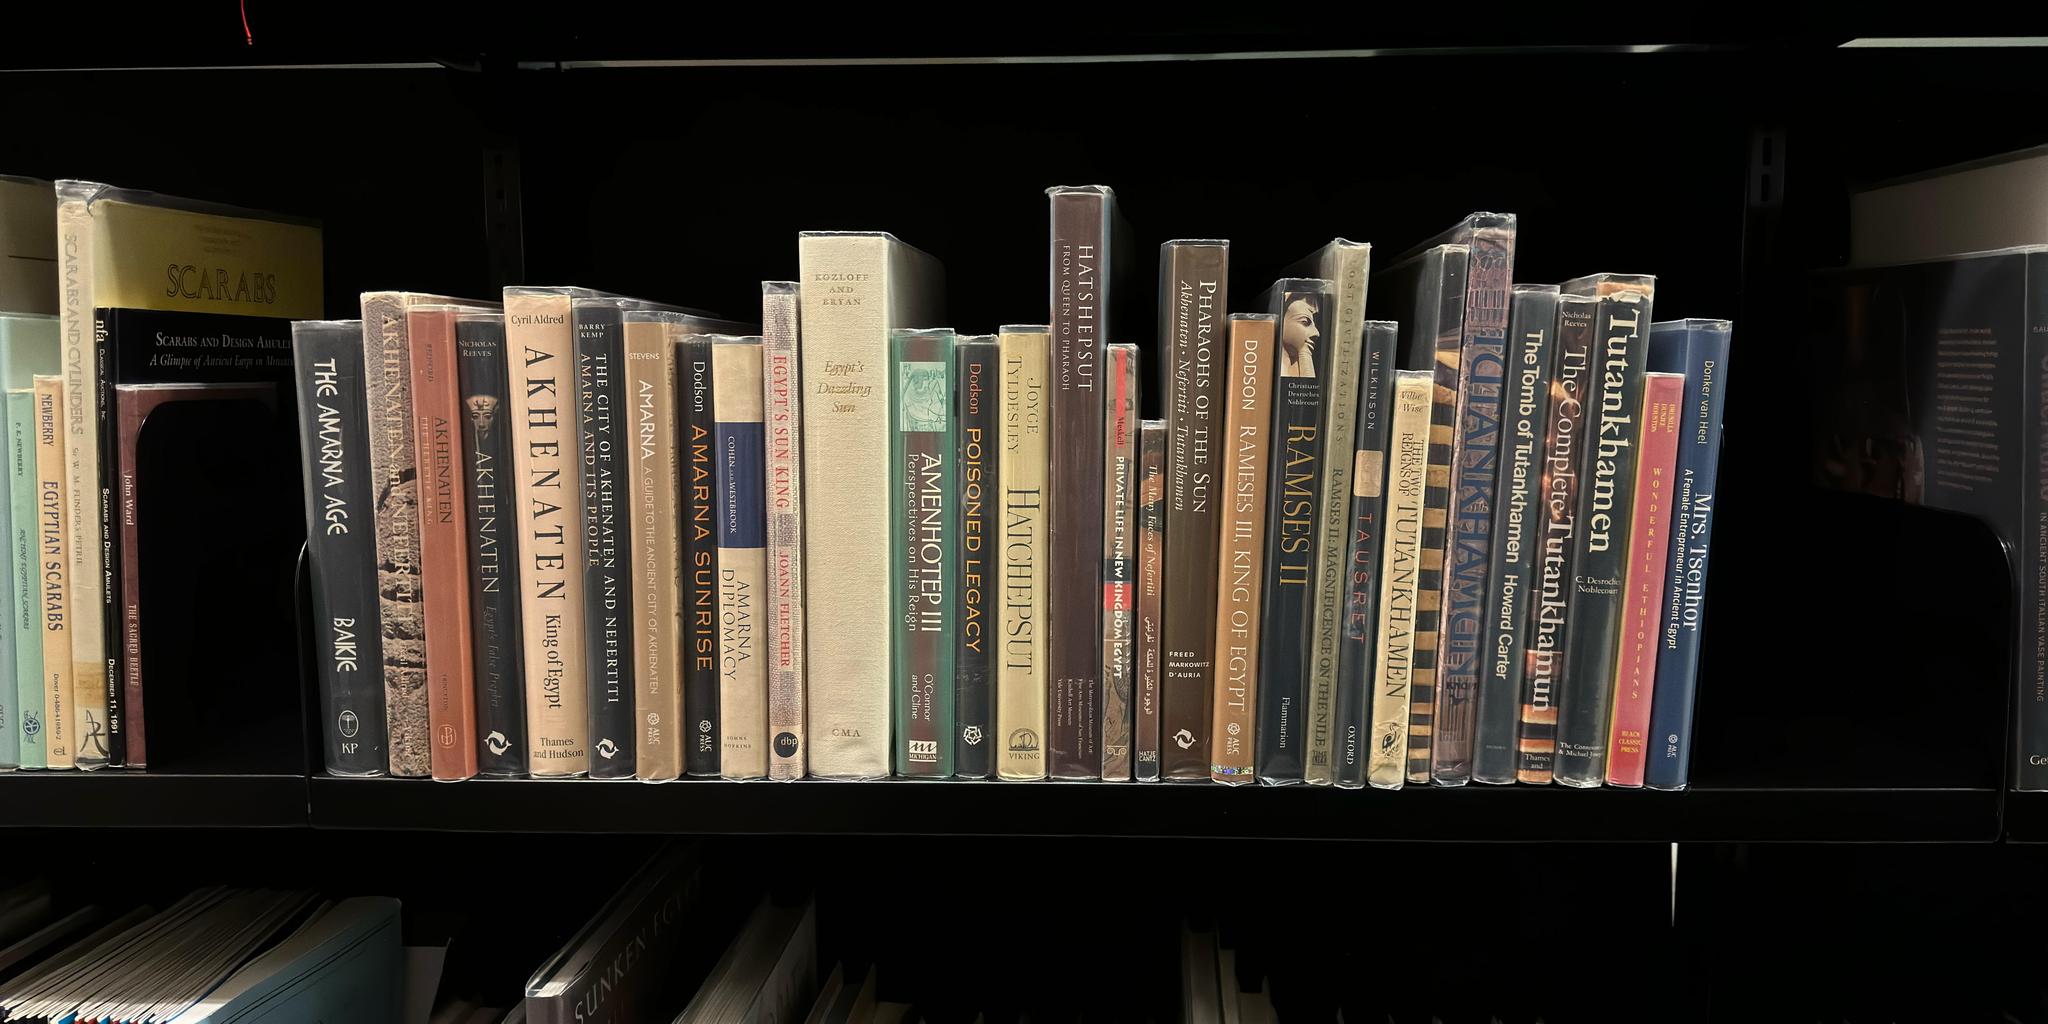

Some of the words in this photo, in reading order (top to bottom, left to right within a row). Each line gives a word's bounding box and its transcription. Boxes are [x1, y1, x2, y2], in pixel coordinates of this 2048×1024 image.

[64, 234, 80, 305] SCARABS
[815, 273, 869, 281] KOZLOFF
[1062, 245, 1071, 275] FROM
[167, 264, 276, 303] SCARABS
[823, 298, 861, 306] BRYAN
[829, 286, 854, 294] AND
[1062, 280, 1071, 316] QUEEN
[66, 309, 80, 346] AND
[95, 320, 108, 342] nfa
[511, 315, 531, 326] Cyril
[533, 314, 564, 324] Aldred
[1062, 322, 1070, 335] TO
[1078, 245, 1093, 392] HATSHEPSUT
[1179, 280, 1192, 348] Akhenaten
[1196, 280, 1217, 388] PHARAOHS
[1562, 311, 1592, 319] Nicholas
[629, 352, 660, 360] STEVENS
[1062, 340, 1070, 391] PHARAOH
[1523, 329, 1544, 365] The
[314, 358, 339, 398] THE
[382, 314, 405, 459] AKHENATEN
[579, 353, 593, 424] AMARNA
[595, 354, 607, 387] THE
[693, 361, 707, 412] Dodson
[969, 363, 982, 414] Dodson
[1176, 359, 1191, 415] Nefertiti
[1242, 340, 1258, 410] DODSON
[1562, 346, 1588, 392] The
[1702, 361, 1715, 398] Donker
[67, 347, 84, 435] CYLINDERS
[773, 356, 789, 425] EGYPT'S
[817, 382, 871, 397] Dazzling
[831, 401, 856, 413] Sun
[1007, 356, 1022, 454] TYLDESLEY
[1025, 377, 1042, 434] JOYCE
[1195, 396, 1209, 421] OF
[1367, 351, 1380, 430] WILKINSON
[1518, 366, 1540, 416] Tomb
[1700, 399, 1710, 419] van
[41, 393, 54, 447] NEWBERRY
[597, 394, 610, 434] CITY
[638, 380, 656, 460] AMARNA
[1517, 420, 1534, 438] of
[1589, 309, 1641, 552] Tutankhamen
[1697, 421, 1709, 444] Heel
[317, 403, 345, 487] AMARNA
[585, 431, 596, 466] AND
[600, 440, 611, 462] OF
[774, 427, 789, 459] SUN
[1194, 426, 1208, 465] THE
[1400, 433, 1414, 480] REIGNS
[1411, 440, 1425, 465] THE
[1547, 398, 1581, 511] Complete
[123, 475, 133, 497] John
[434, 417, 453, 524] AKHENATEN
[525, 345, 566, 600] AKHENATEN
[586, 474, 597, 498] ITS
[644, 467, 654, 475] A
[692, 425, 710, 541] AMARNA
[775, 467, 790, 508] KING
[1116, 456, 1124, 506] PRIVATE
[1149, 465, 1157, 482] The
[1175, 426, 1188, 511] Tutankhamen
[1236, 426, 1257, 513] RAMESES
[1280, 423, 1317, 553] RAMSES
[1409, 468, 1422, 497] TWO
[1684, 468, 1694, 478] A
[644, 477, 654, 506] GUIDE
[907, 454, 919, 541] Perspectives
[966, 428, 982, 552] POISONED
[1192, 473, 1210, 513] SUN
[1329, 468, 1344, 528] RAMSES
[1398, 481, 1410, 497] OF
[1506, 440, 1533, 563] Tutankhamen
[1681, 478, 1693, 511] Female
[43, 481, 61, 555] EGYPTIAN
[124, 500, 134, 525] Ward
[324, 494, 350, 536] AGE
[475, 451, 500, 593] AKHENATEN
[600, 468, 615, 568] AKHENATEN
[645, 507, 655, 525] TO
[921, 453, 942, 605] AMENHOTEP
[1115, 510, 1124, 533] LIFE
[1148, 516, 1157, 541] Faces
[1645, 467, 1662, 573] WONDERFUL
[1690, 492, 1712, 540] Mrs.
[587, 505, 599, 566] PEOPLE
[645, 525, 655, 545] THE
[908, 547, 917, 563] on
[1115, 536, 1124, 549] IN
[1146, 543, 1156, 556] of
[1674, 513, 1690, 574] Entrepreneur
[646, 545, 656, 591] ANCIENT
[779, 552, 790, 598] JOANN
[908, 569, 919, 590] His
[1006, 486, 1040, 675] HATCHEPSUT
[1114, 551, 1123, 578] NEW
[1146, 556, 1156, 596] Nefertiti
[1232, 551, 1251, 602] KING
[1280, 562, 1309, 587] II
[1351, 513, 1372, 644] TAUSRET
[1674, 575, 1684, 584] in
[2039, 566, 2047, 596] SOUTH
[45, 561, 64, 632] SCARABS
[603, 576, 616, 609] AND
[648, 592, 657, 616] CITY
[966, 560, 981, 653] LEGACY
[1322, 545, 1339, 656] MAGNIFICENCE
[1386, 501, 1418, 700] TUTANKHAMEN
[1501, 574, 1519, 630] Howard
[1671, 586, 1683, 620] Ancient
[1682, 544, 1708, 632] Tsenhor
[128, 604, 137, 622] THE
[648, 617, 658, 629] OF
[694, 551, 713, 671] SUNRISE
[722, 569, 736, 680] DIPLOMACY
[737, 581, 751, 661] AMARNA
[905, 595, 919, 632] Reign
[921, 611, 942, 632] III
[1113, 581, 1123, 639] KINGDOM
[1231, 610, 1249, 639] OF
[1532, 512, 1575, 712] Tutankhamun
[2038, 598, 2046, 633] ITALIAN
[128, 624, 138, 655] SACRED
[333, 617, 358, 673] BAIKIE
[542, 614, 561, 648] King
[780, 603, 790, 667] FLETCHER
[1632, 583, 1649, 700] ETHIOPIANS
[1667, 623, 1680, 649] Egypt
[2037, 635, 2045, 658] VASE
[547, 650, 563, 669] of
[605, 617, 619, 703] NEFERTITI
[648, 630, 659, 694] AKHENATEN
[1113, 642, 1122, 678] EGYPT
[1319, 658, 1331, 679] ON
[1496, 635, 1513, 680] Carter
[544, 669, 562, 709] Egypt
[912, 675, 921, 691] and
[1228, 646, 1247, 712] EGYPT
[1317, 681, 1329, 711] THE
[2036, 659, 2045, 703] PAINTING
[911, 691, 921, 719] Cline
[1280, 697, 1291, 749] Flammarion
[342, 743, 358, 754] KP
[540, 737, 574, 746] Thames
[780, 737, 798, 747] dbp
[832, 729, 861, 737] CMA
[1315, 713, 1329, 747] NILE
[1346, 725, 1356, 765] OXFORD
[534, 750, 547, 759] and
[549, 749, 584, 759] Hudson
[1525, 754, 1550, 762] Thames
